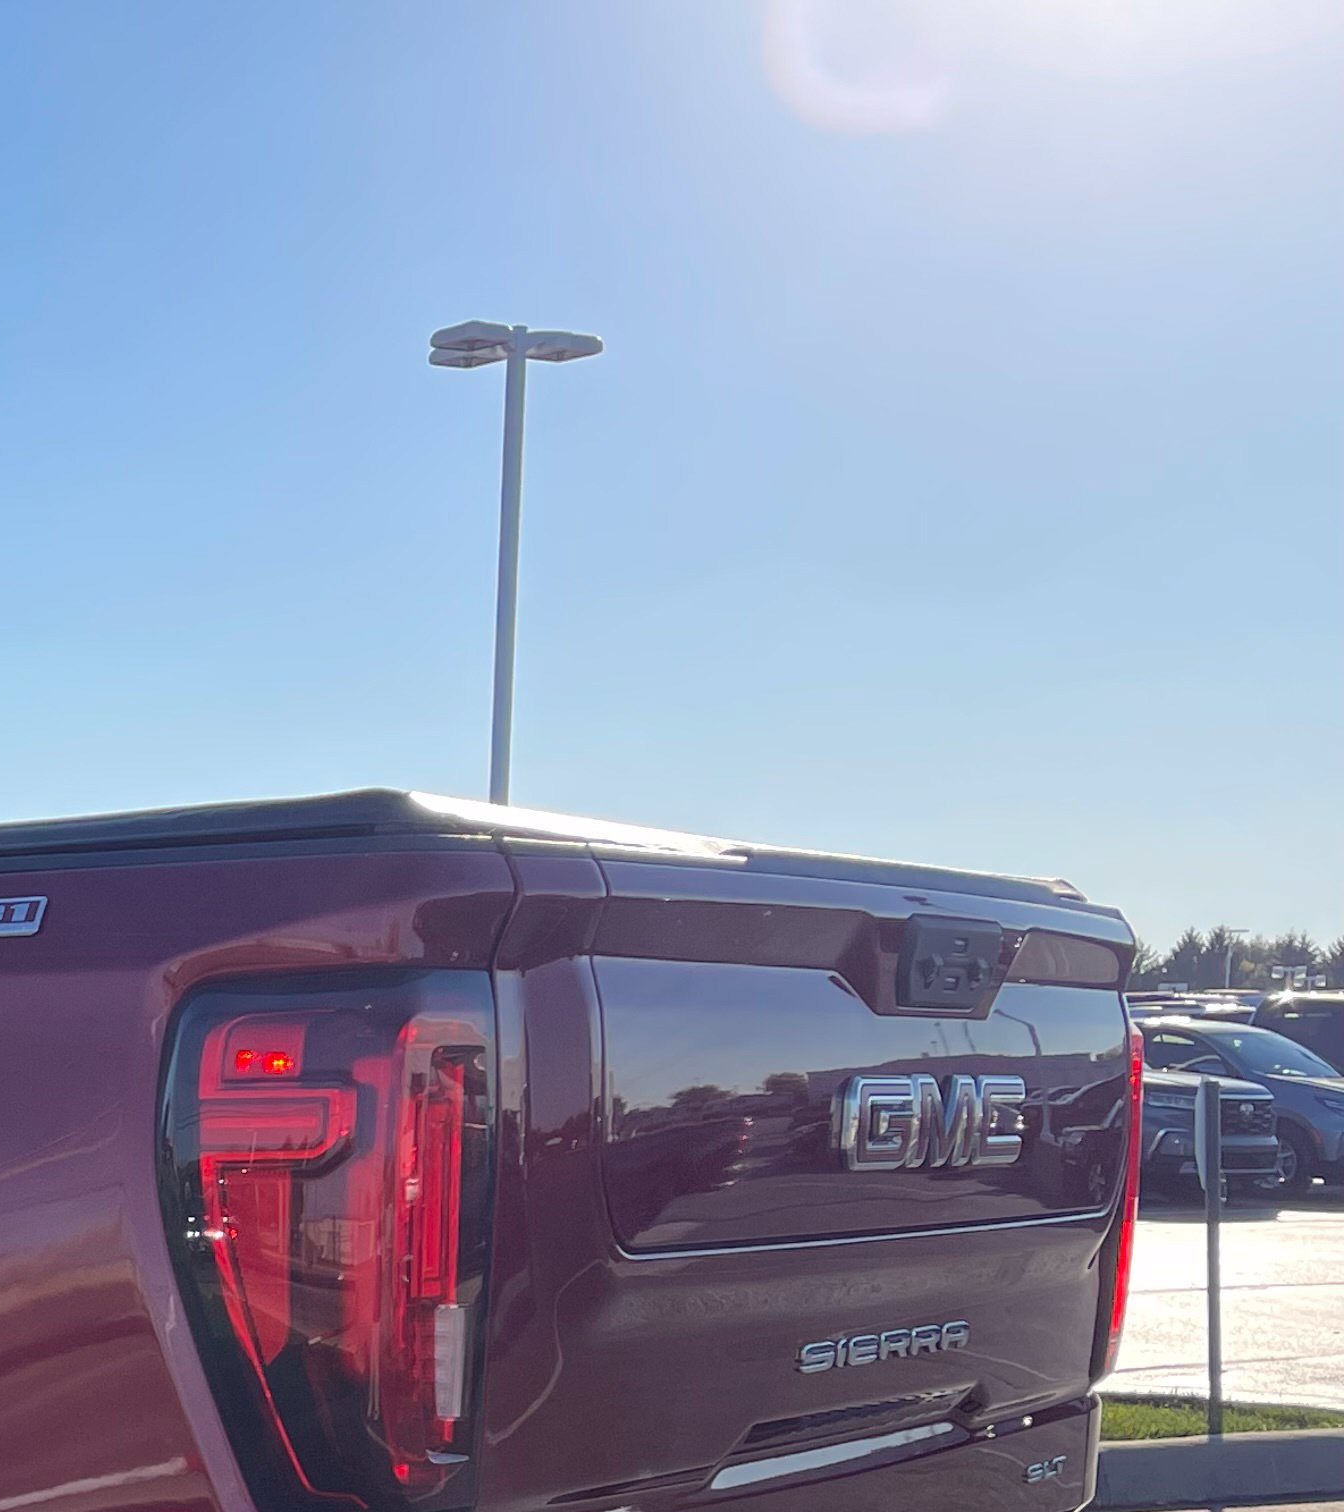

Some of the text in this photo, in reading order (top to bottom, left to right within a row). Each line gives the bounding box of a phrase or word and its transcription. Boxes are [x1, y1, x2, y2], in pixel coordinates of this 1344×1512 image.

[841, 1073, 1026, 1171] GMC
[796, 1320, 970, 1374] SIERRA
[1024, 1455, 1067, 1484] SLT
